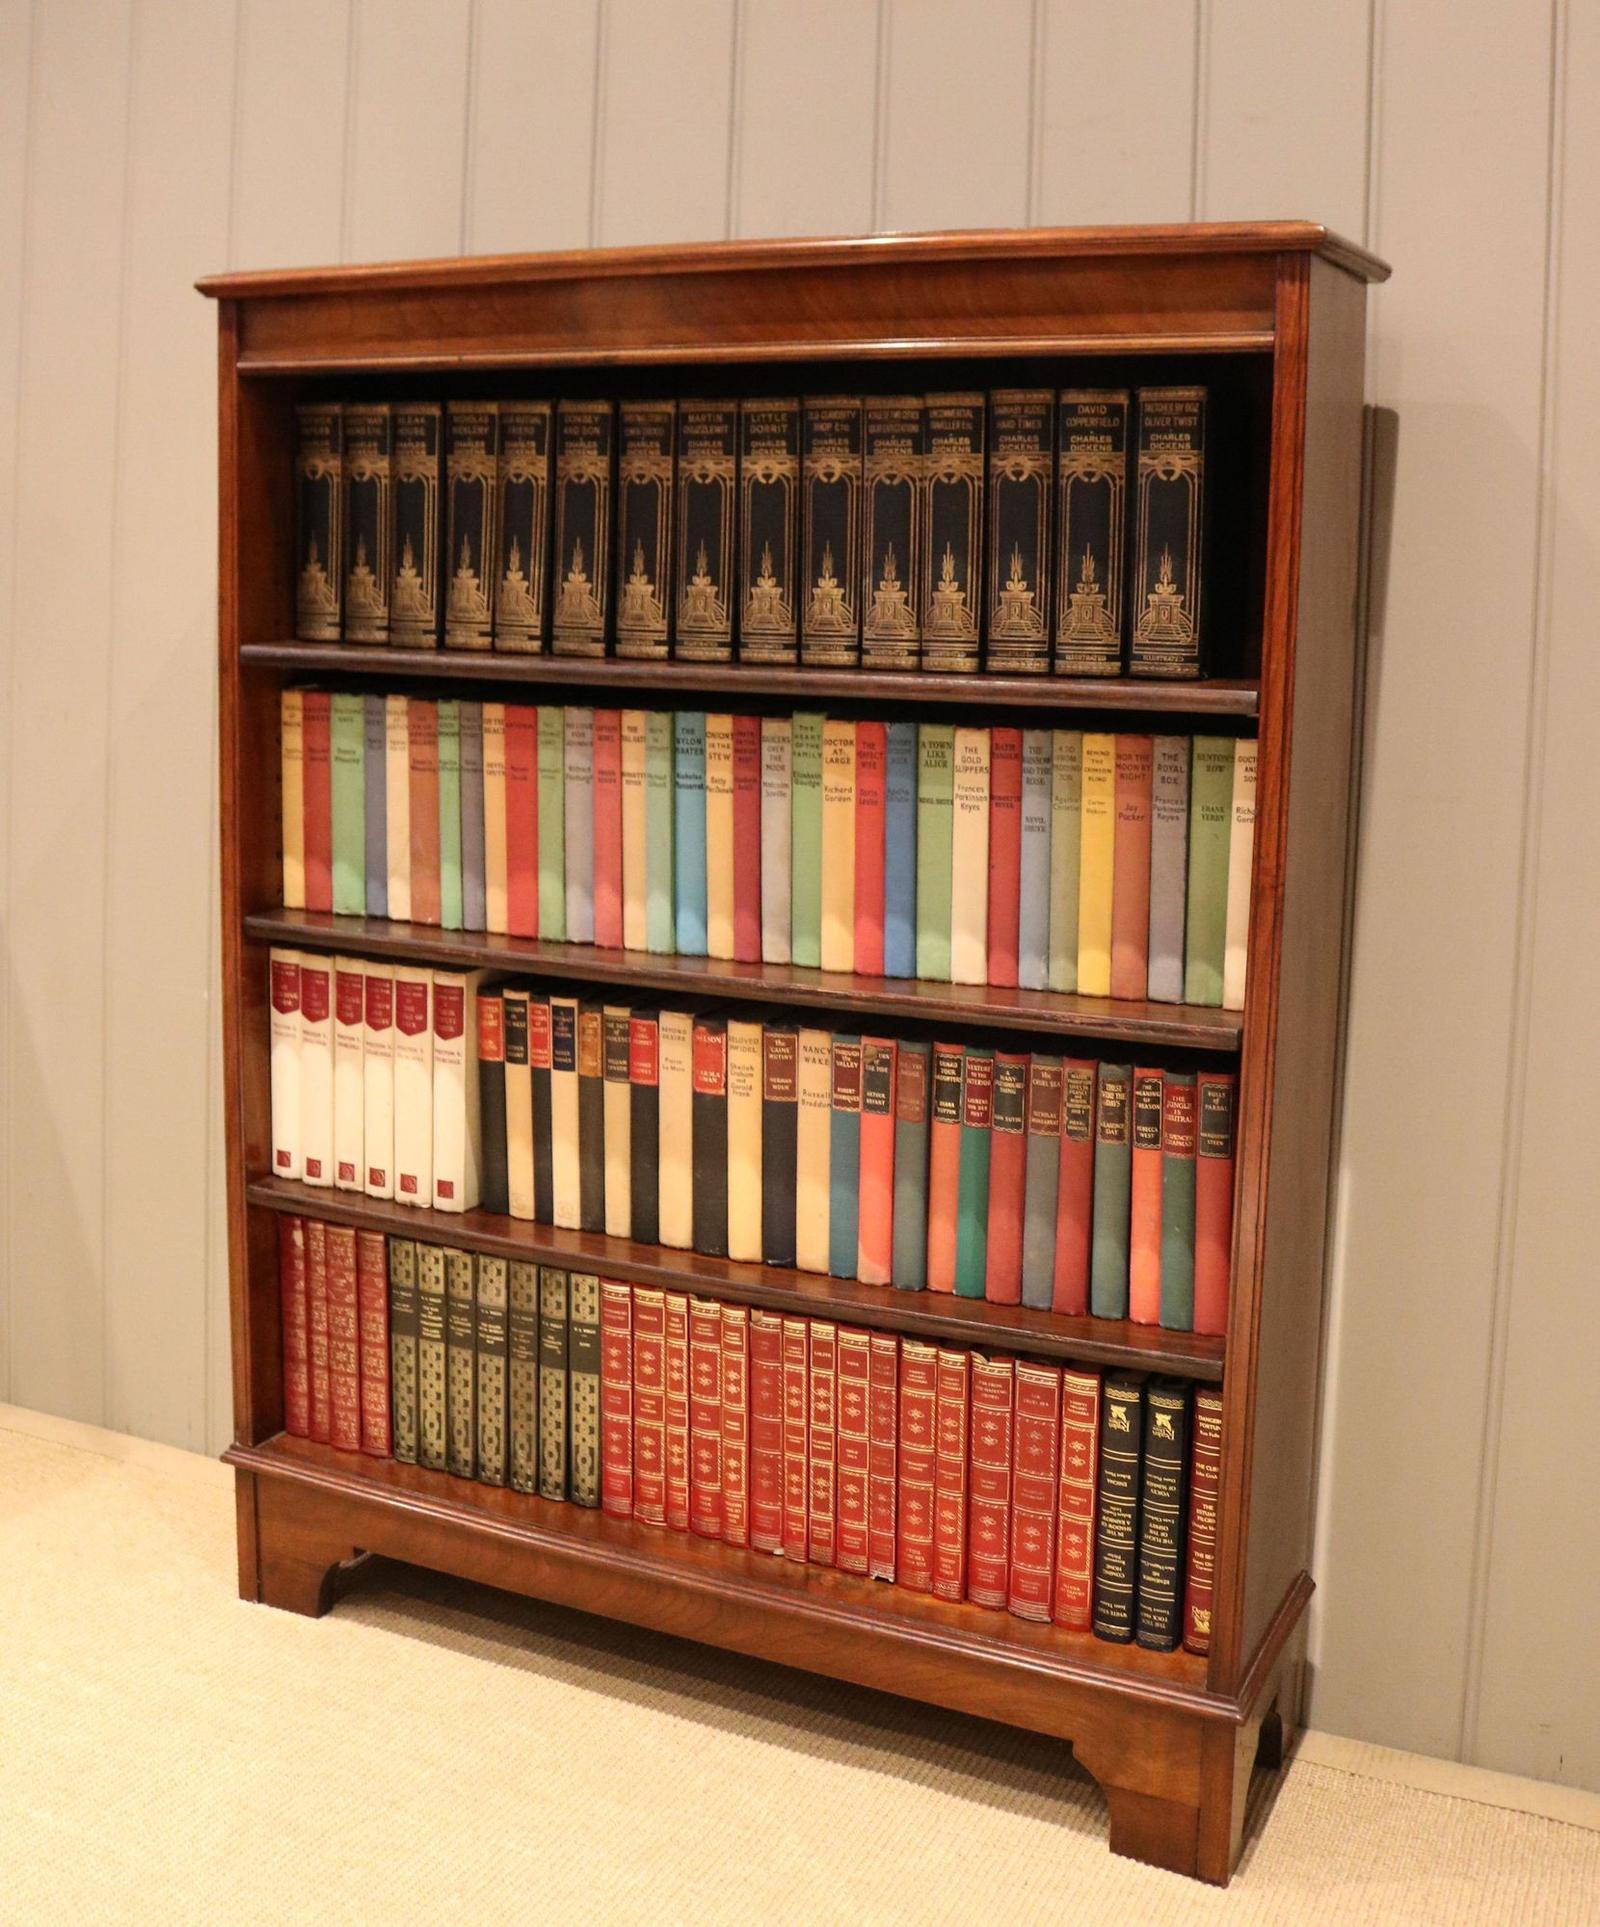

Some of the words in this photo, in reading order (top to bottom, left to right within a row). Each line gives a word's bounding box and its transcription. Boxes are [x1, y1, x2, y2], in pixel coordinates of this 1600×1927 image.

[1077, 404, 1108, 415] DAVID
[688, 412, 723, 423] MARTIN
[751, 412, 788, 423] LITTLE
[1066, 417, 1120, 428] COPPERFIELD
[932, 436, 971, 445] CHARLES
[999, 434, 1040, 443] CHARLES
[1070, 434, 1113, 443] CHARLES
[1150, 432, 1191, 441] CHARLES
[874, 438, 913, 447] CHARLES
[1150, 441, 1192, 451] DICKENS
[998, 443, 1040, 453] DICKENS
[1070, 443, 1113, 453] DICKENS
[823, 739, 854, 747] DOCTOR
[928, 741, 952, 750] TOWN
[708, 752, 731, 761] STEW
[792, 751, 822, 759] FAMILY
[833, 748, 844, 756] AT
[927, 750, 946, 759] LIKE
[1086, 749, 1110, 757] BEHIND
[825, 757, 850, 765] LARGE
[961, 756, 982, 764] GOLD
[1117, 753, 1133, 761] NOR
[1161, 753, 1178, 761] THE
[924, 760, 947, 768] ALICE
[1116, 762, 1139, 772] MOON
[955, 765, 989, 774] SLIPPERS
[1157, 764, 1185, 774] ROYAL
[1161, 775, 1178, 784] BOX
[824, 785, 852, 794] Richard
[958, 784, 984, 793] Frances
[824, 794, 851, 802] Gordon
[955, 793, 988, 801] Parkinson
[960, 802, 980, 813] Keyes
[1124, 802, 1138, 812] Joy
[1200, 805, 1225, 813] FRANK
[1119, 812, 1145, 823] Packer
[1201, 813, 1225, 822] YERBY
[802, 1045, 831, 1054] NANCY
[804, 1055, 829, 1066] WAKE
[835, 1061, 858, 1069] VALLEY
[1041, 1071, 1051, 1079] The
[1032, 1078, 1049, 1087] CRUEL
[1049, 1080, 1061, 1088] SEA
[802, 1088, 831, 1097] Russell
[802, 1098, 832, 1108] Braddon
[1105, 1100, 1121, 1108] DAYS
[1167, 1100, 1192, 1110] JUNGLE
[1105, 1128, 1119, 1136] DAY
[1140, 1131, 1155, 1139] WEST
